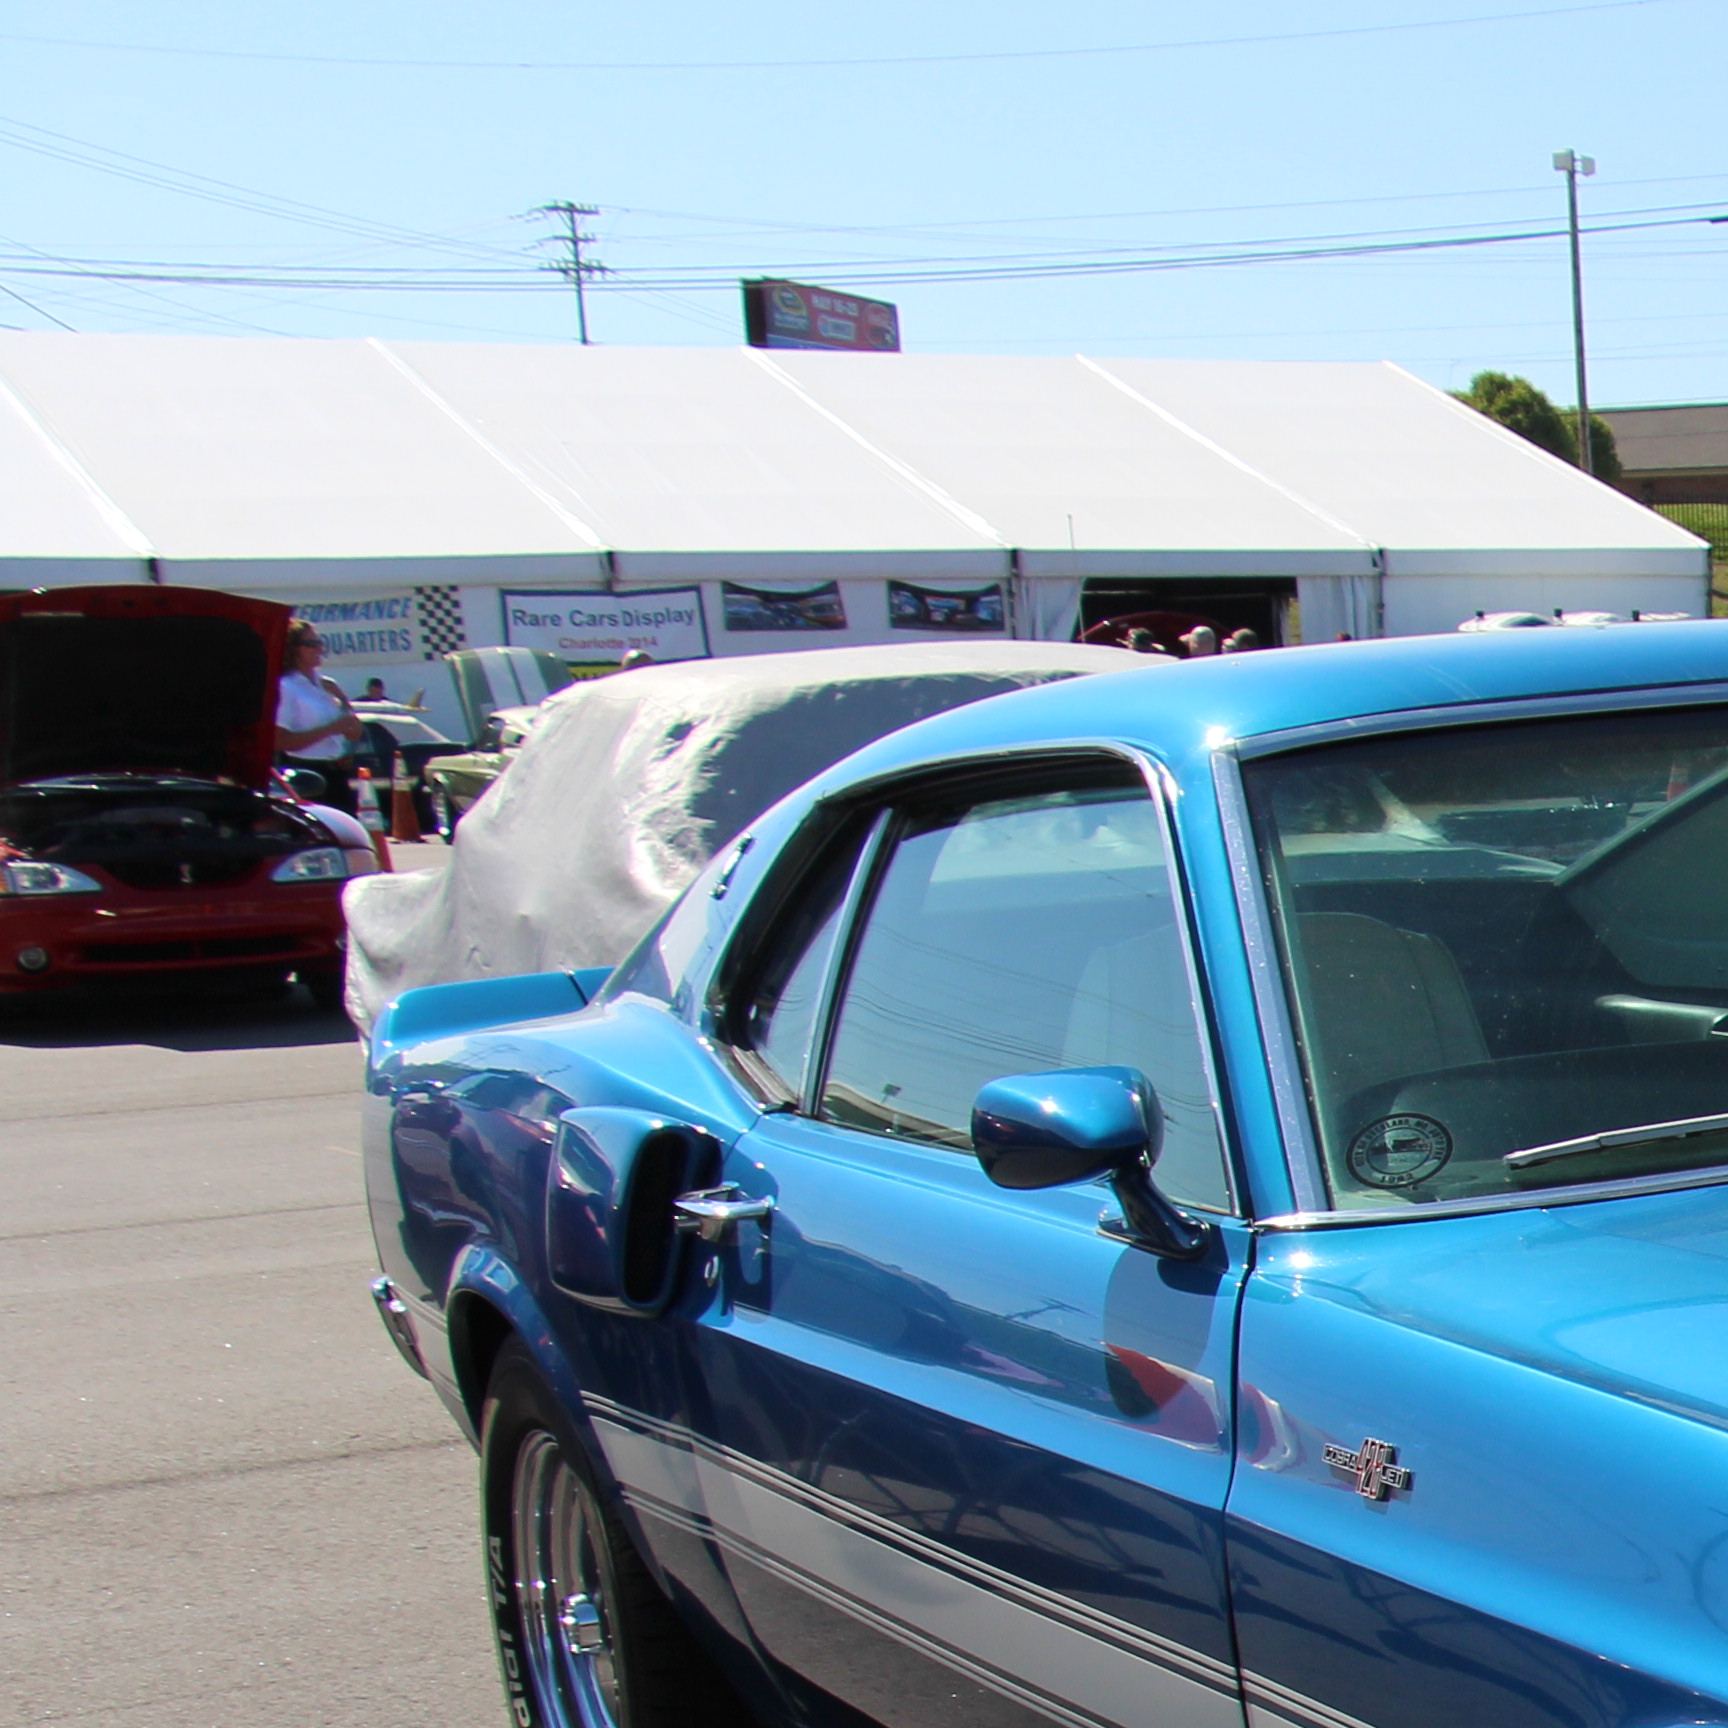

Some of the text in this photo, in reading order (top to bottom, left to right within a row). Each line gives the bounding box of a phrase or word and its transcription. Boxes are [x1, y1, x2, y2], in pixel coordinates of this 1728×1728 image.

[511, 607, 695, 628] Rare Cars Display
[558, 636, 658, 649] Charlotte 2014
[1381, 1463, 1403, 1488] JET
